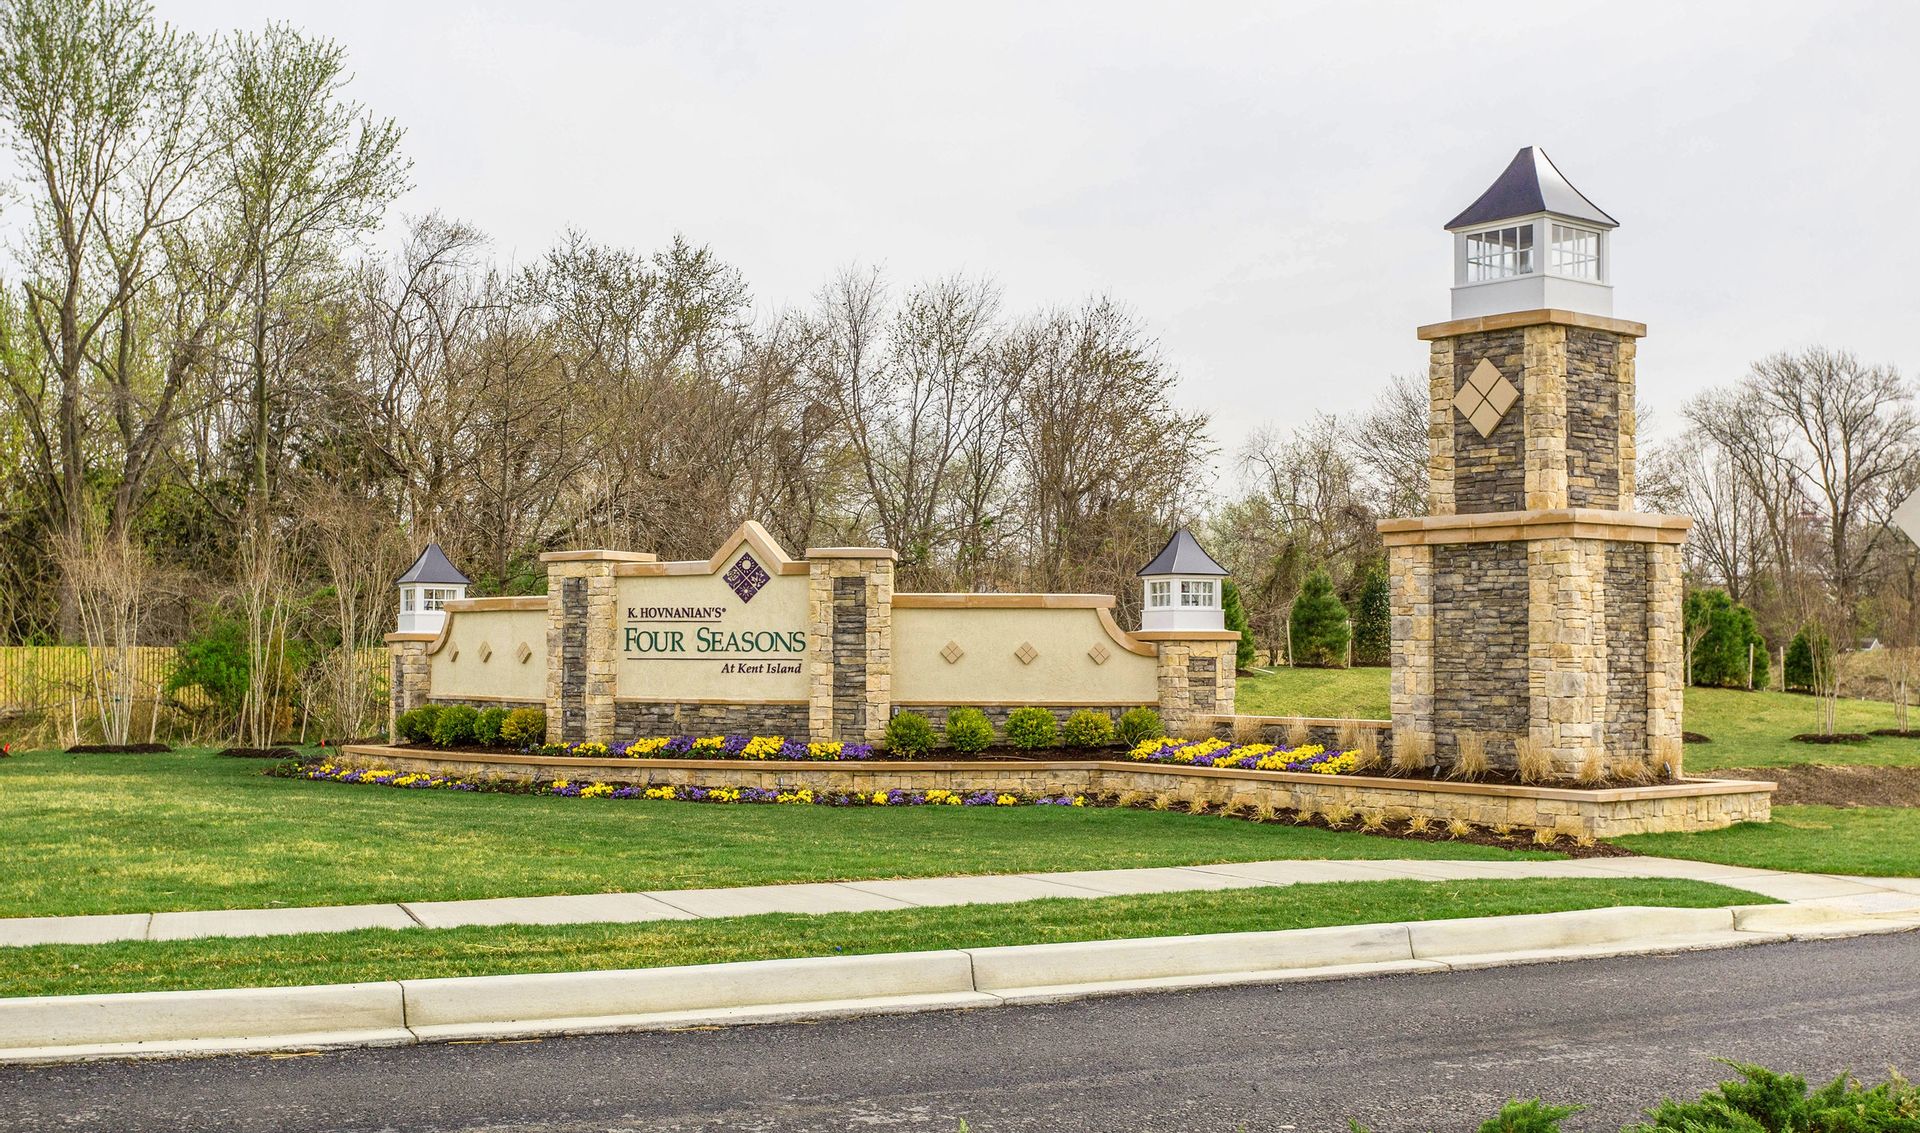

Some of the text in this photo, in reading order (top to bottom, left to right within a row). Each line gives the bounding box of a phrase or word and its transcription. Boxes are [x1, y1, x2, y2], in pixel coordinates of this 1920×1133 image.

[627, 607, 638, 618] K.
[624, 627, 806, 653] FOUR SEASONS
[721, 663, 801, 674] At Kent Island
